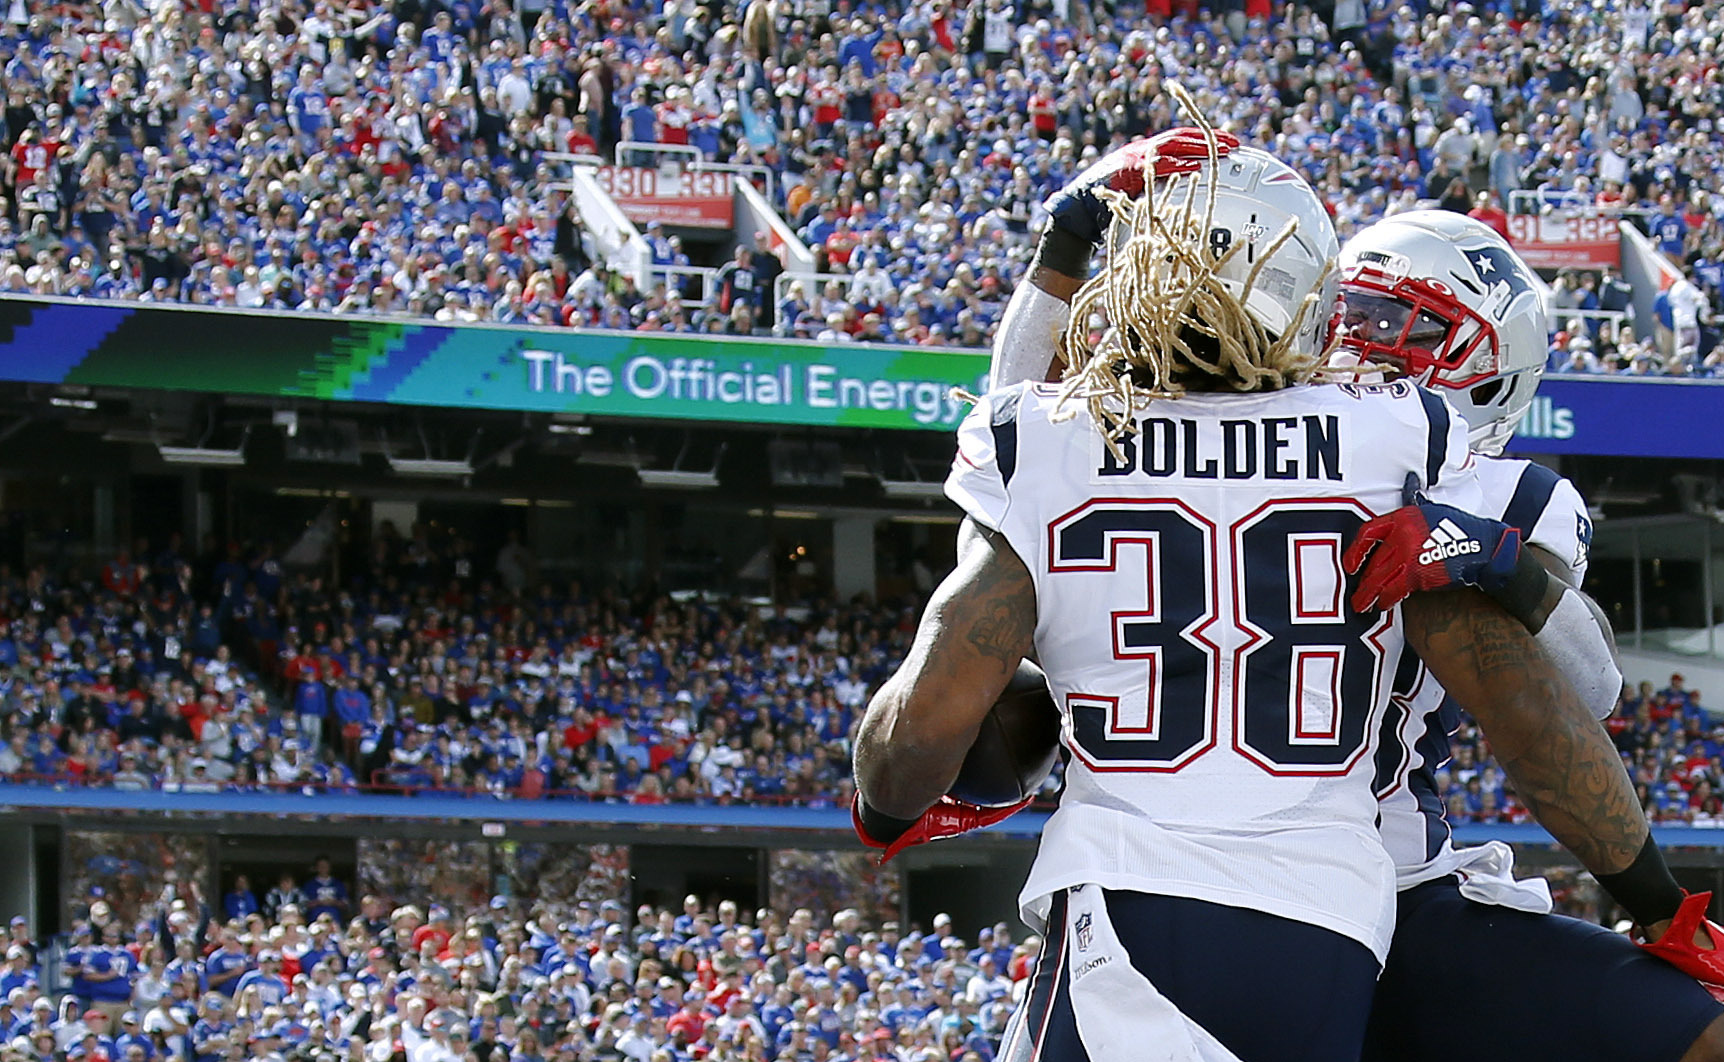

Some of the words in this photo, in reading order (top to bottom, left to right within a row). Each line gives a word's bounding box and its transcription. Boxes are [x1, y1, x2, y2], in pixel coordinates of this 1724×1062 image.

[522, 350, 613, 396] The
[624, 356, 792, 405] Official
[808, 365, 968, 422] Energy
[1098, 414, 1343, 481] BOLDEN
[1418, 538, 1481, 566] adidas
[1048, 497, 1393, 776] 38
